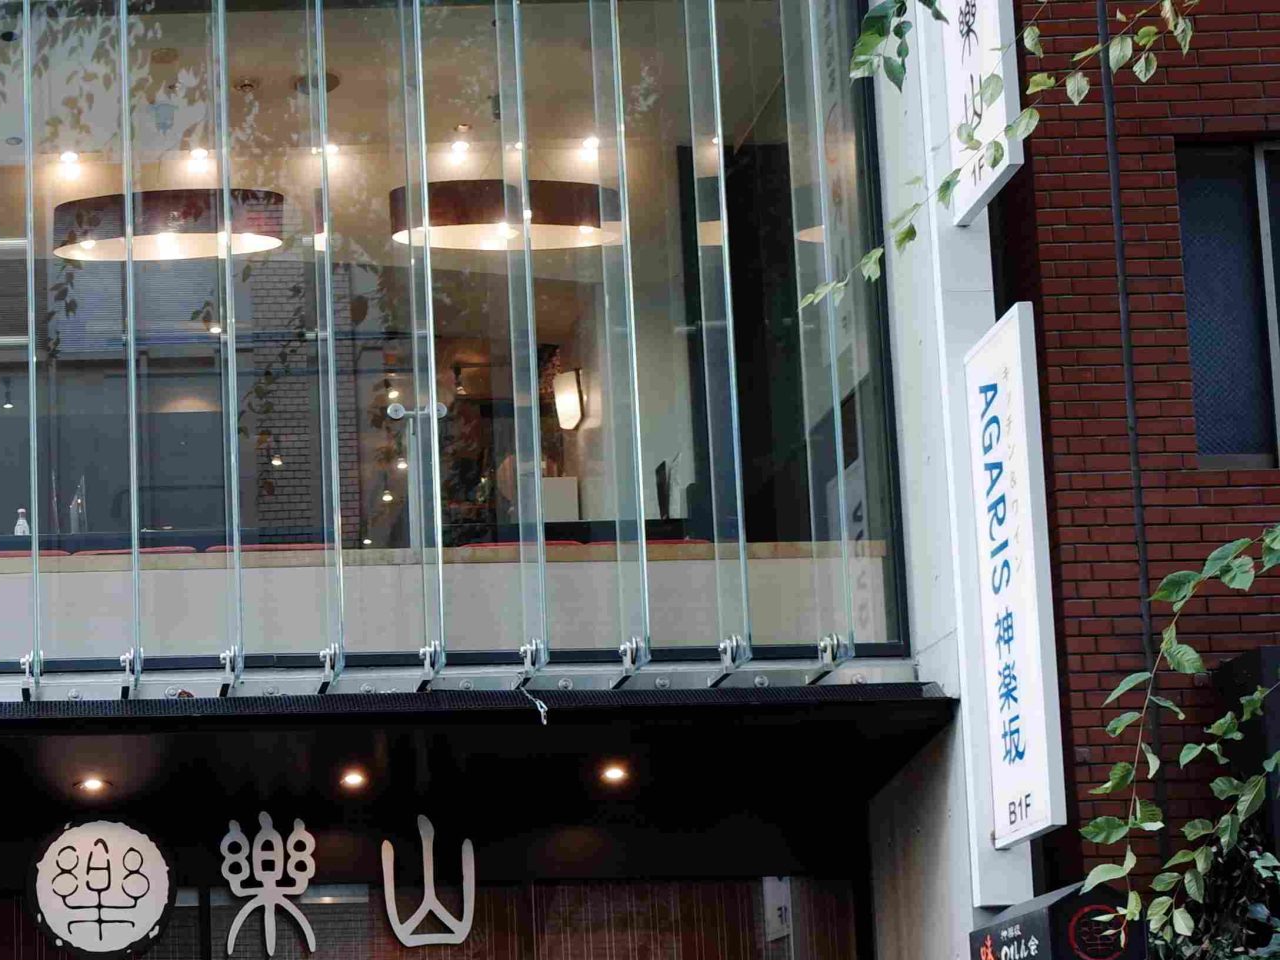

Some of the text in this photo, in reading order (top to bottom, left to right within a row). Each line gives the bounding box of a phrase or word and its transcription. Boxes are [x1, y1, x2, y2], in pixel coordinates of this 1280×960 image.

[970, 153, 985, 187] 1F
[978, 382, 1012, 596] AGARIS
[993, 606, 1027, 766] 神楽坂
[1008, 793, 1032, 826] B1F
